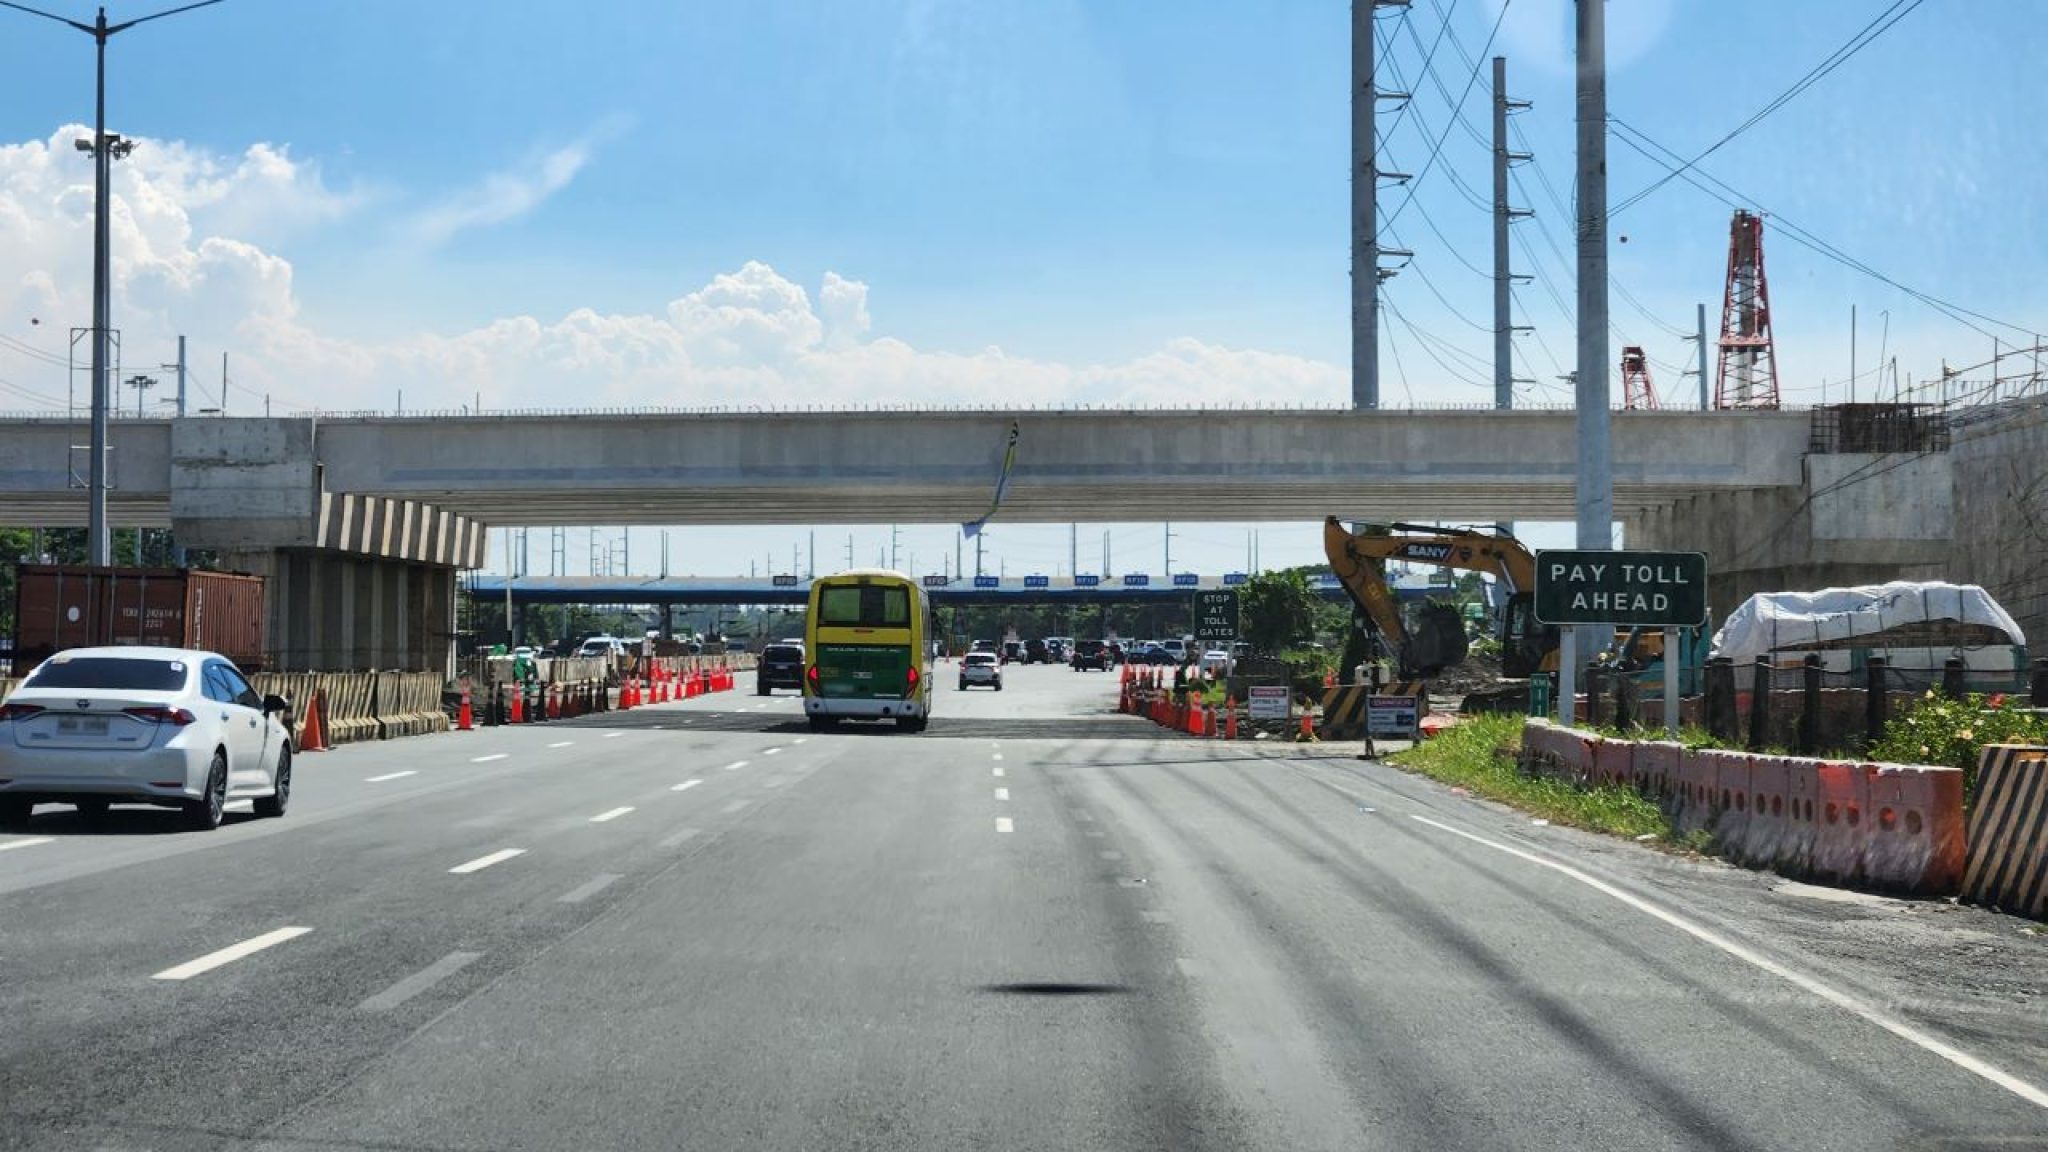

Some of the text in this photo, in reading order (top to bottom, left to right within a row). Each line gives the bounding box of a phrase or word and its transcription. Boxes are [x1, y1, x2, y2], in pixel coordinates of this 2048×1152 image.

[1407, 545, 1448, 557] SANY
[1551, 564, 1689, 584] PAY TOLL
[1204, 594, 1230, 603] STOP
[1571, 592, 1668, 611] AHEAD
[1210, 606, 1223, 614] AT
[1203, 617, 1229, 625] TOLL
[1200, 628, 1233, 636] GATES
